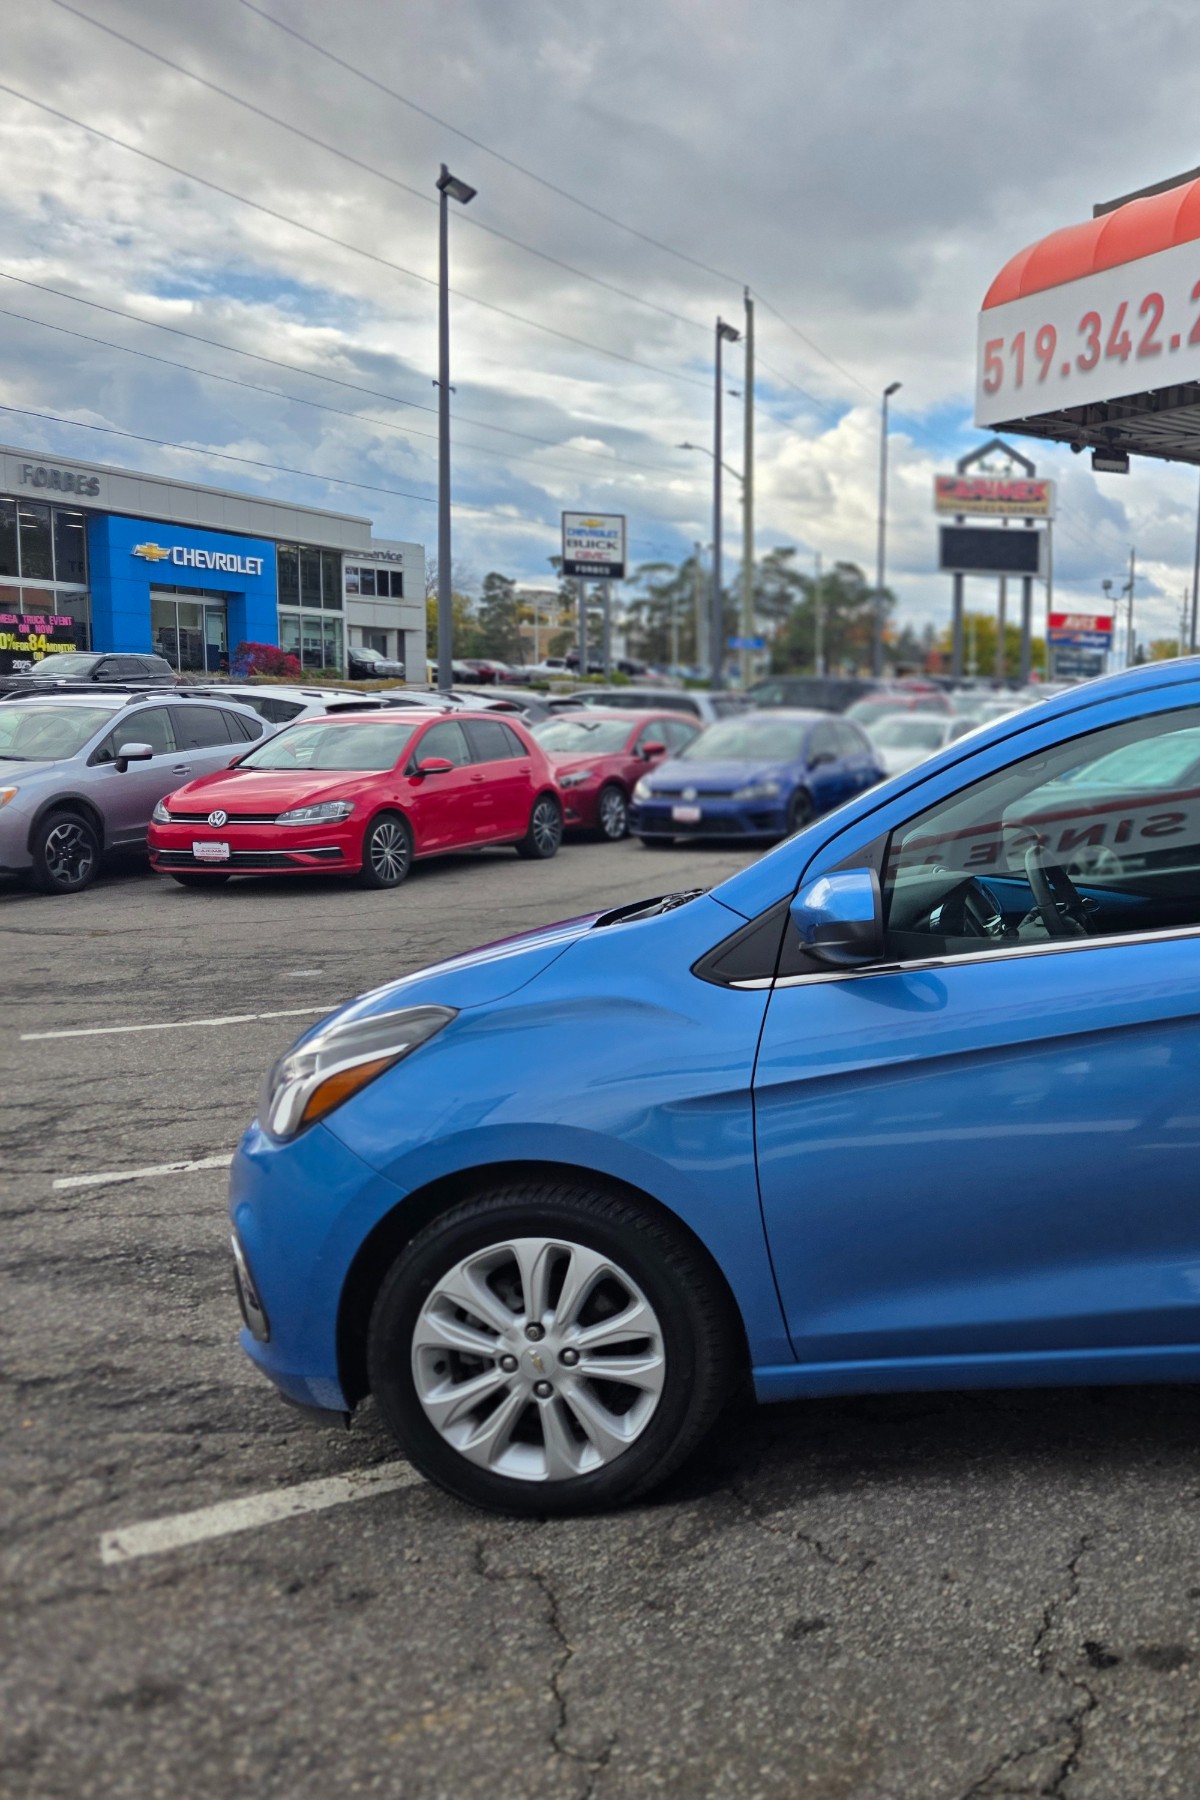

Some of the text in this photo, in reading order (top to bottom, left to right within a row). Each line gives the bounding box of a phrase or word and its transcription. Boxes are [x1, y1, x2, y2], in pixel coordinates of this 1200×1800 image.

[18, 463, 100, 497] FORBES
[566, 539, 618, 550] BUICK
[172, 546, 264, 576] CHEVROLET
[22, 615, 46, 625] TRUCK
[48, 616, 73, 626] EVENT
[18, 624, 54, 634] ON NOW
[28, 634, 46, 651] 84
[46, 643, 77, 653] MONTHS
